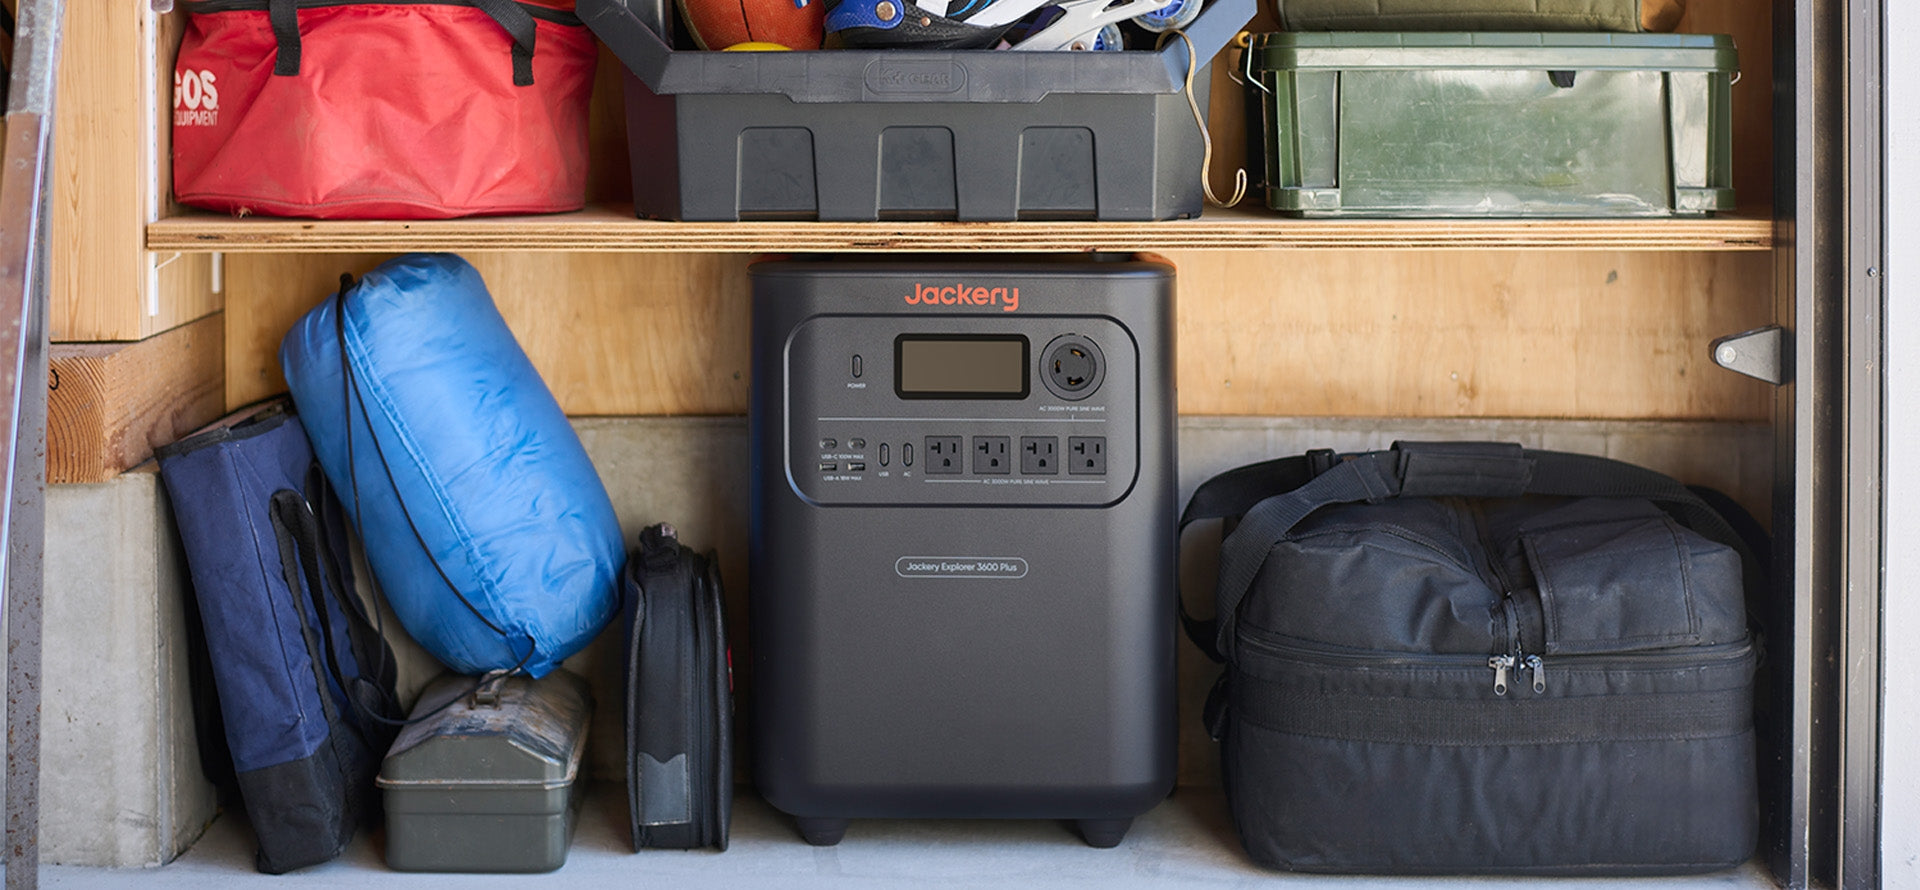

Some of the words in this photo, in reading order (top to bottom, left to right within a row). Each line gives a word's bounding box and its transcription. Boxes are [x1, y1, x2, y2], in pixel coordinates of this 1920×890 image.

[904, 283, 1019, 312] Jackery
[907, 562, 940, 572] Jackery
[941, 562, 976, 573] Explorer
[976, 563, 999, 572] 3600
[1000, 563, 1018, 572] Plus
